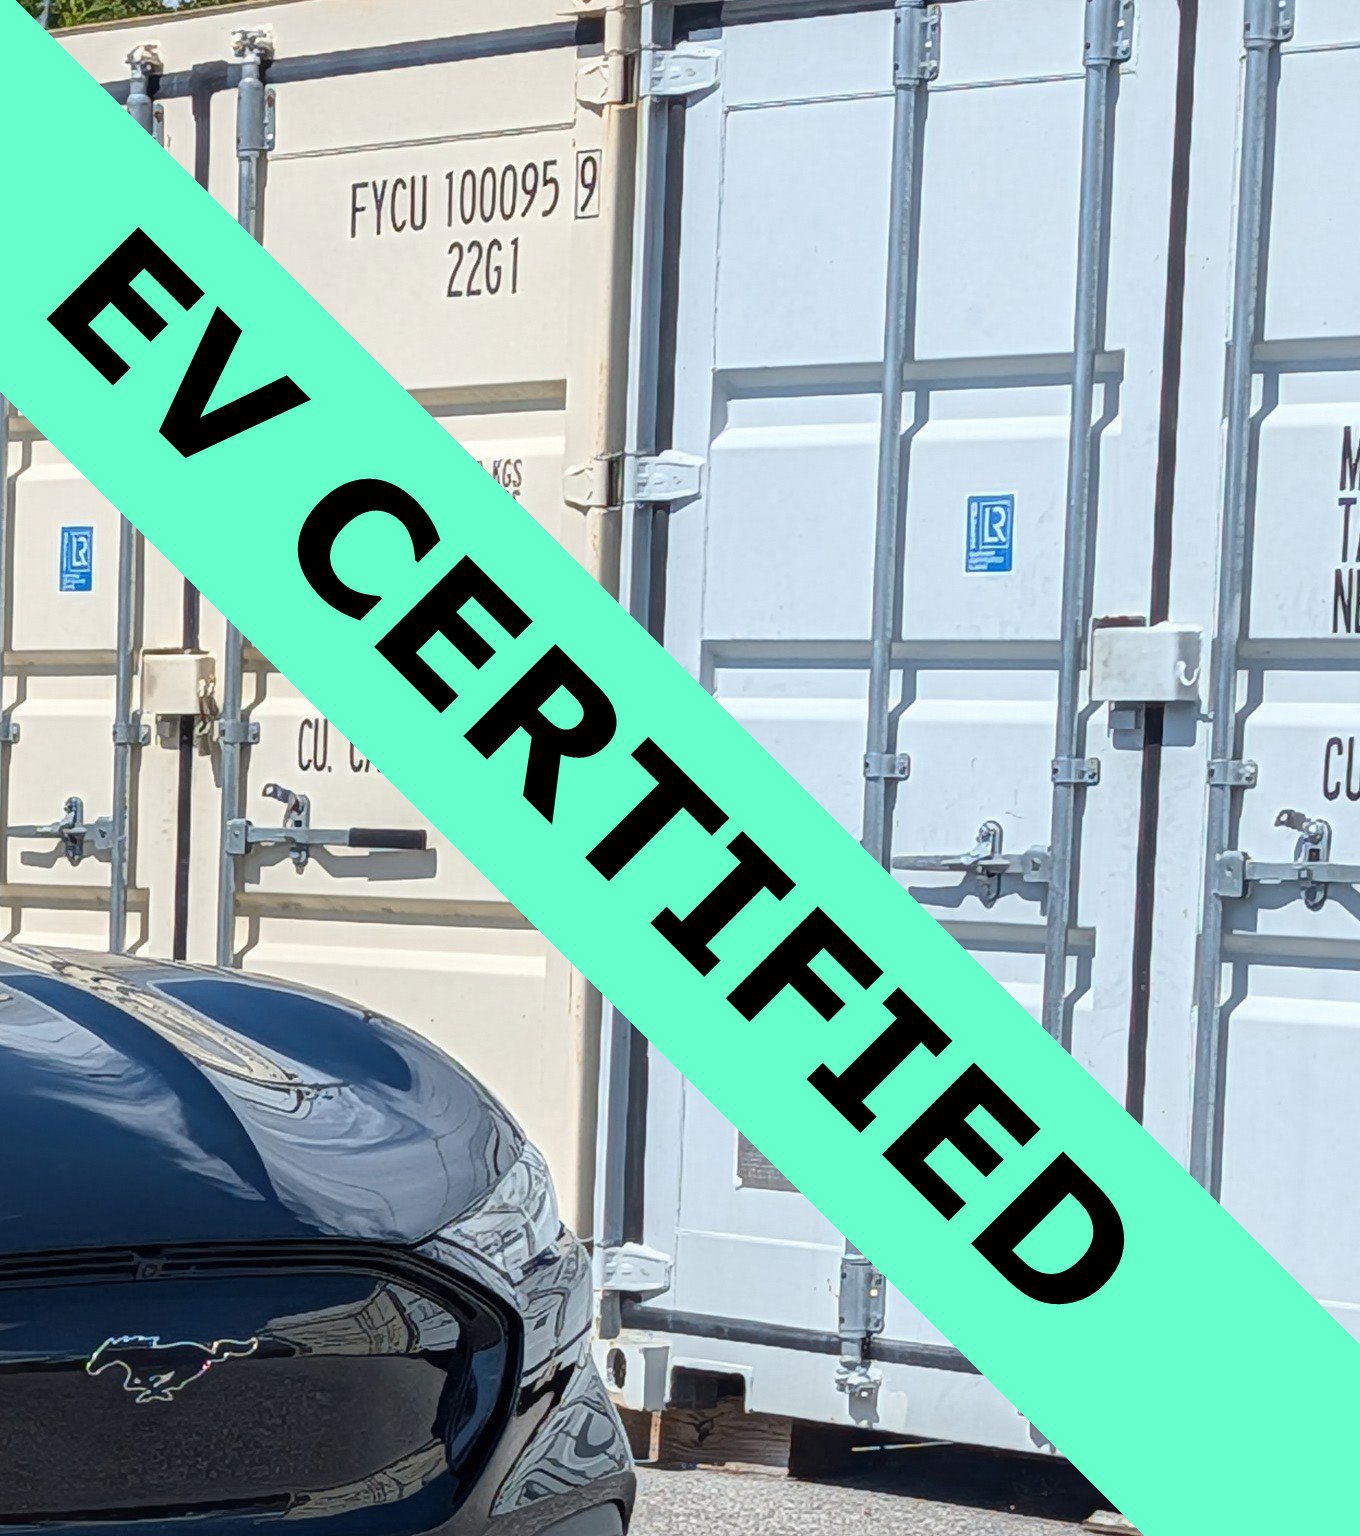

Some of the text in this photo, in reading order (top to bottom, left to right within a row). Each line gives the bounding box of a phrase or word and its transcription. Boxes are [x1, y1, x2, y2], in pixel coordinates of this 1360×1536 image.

[350, 155, 598, 239] FYCU 100095 9
[446, 236, 520, 298] 22G1
[492, 458, 523, 488] KGS
[298, 718, 332, 773] CU.
